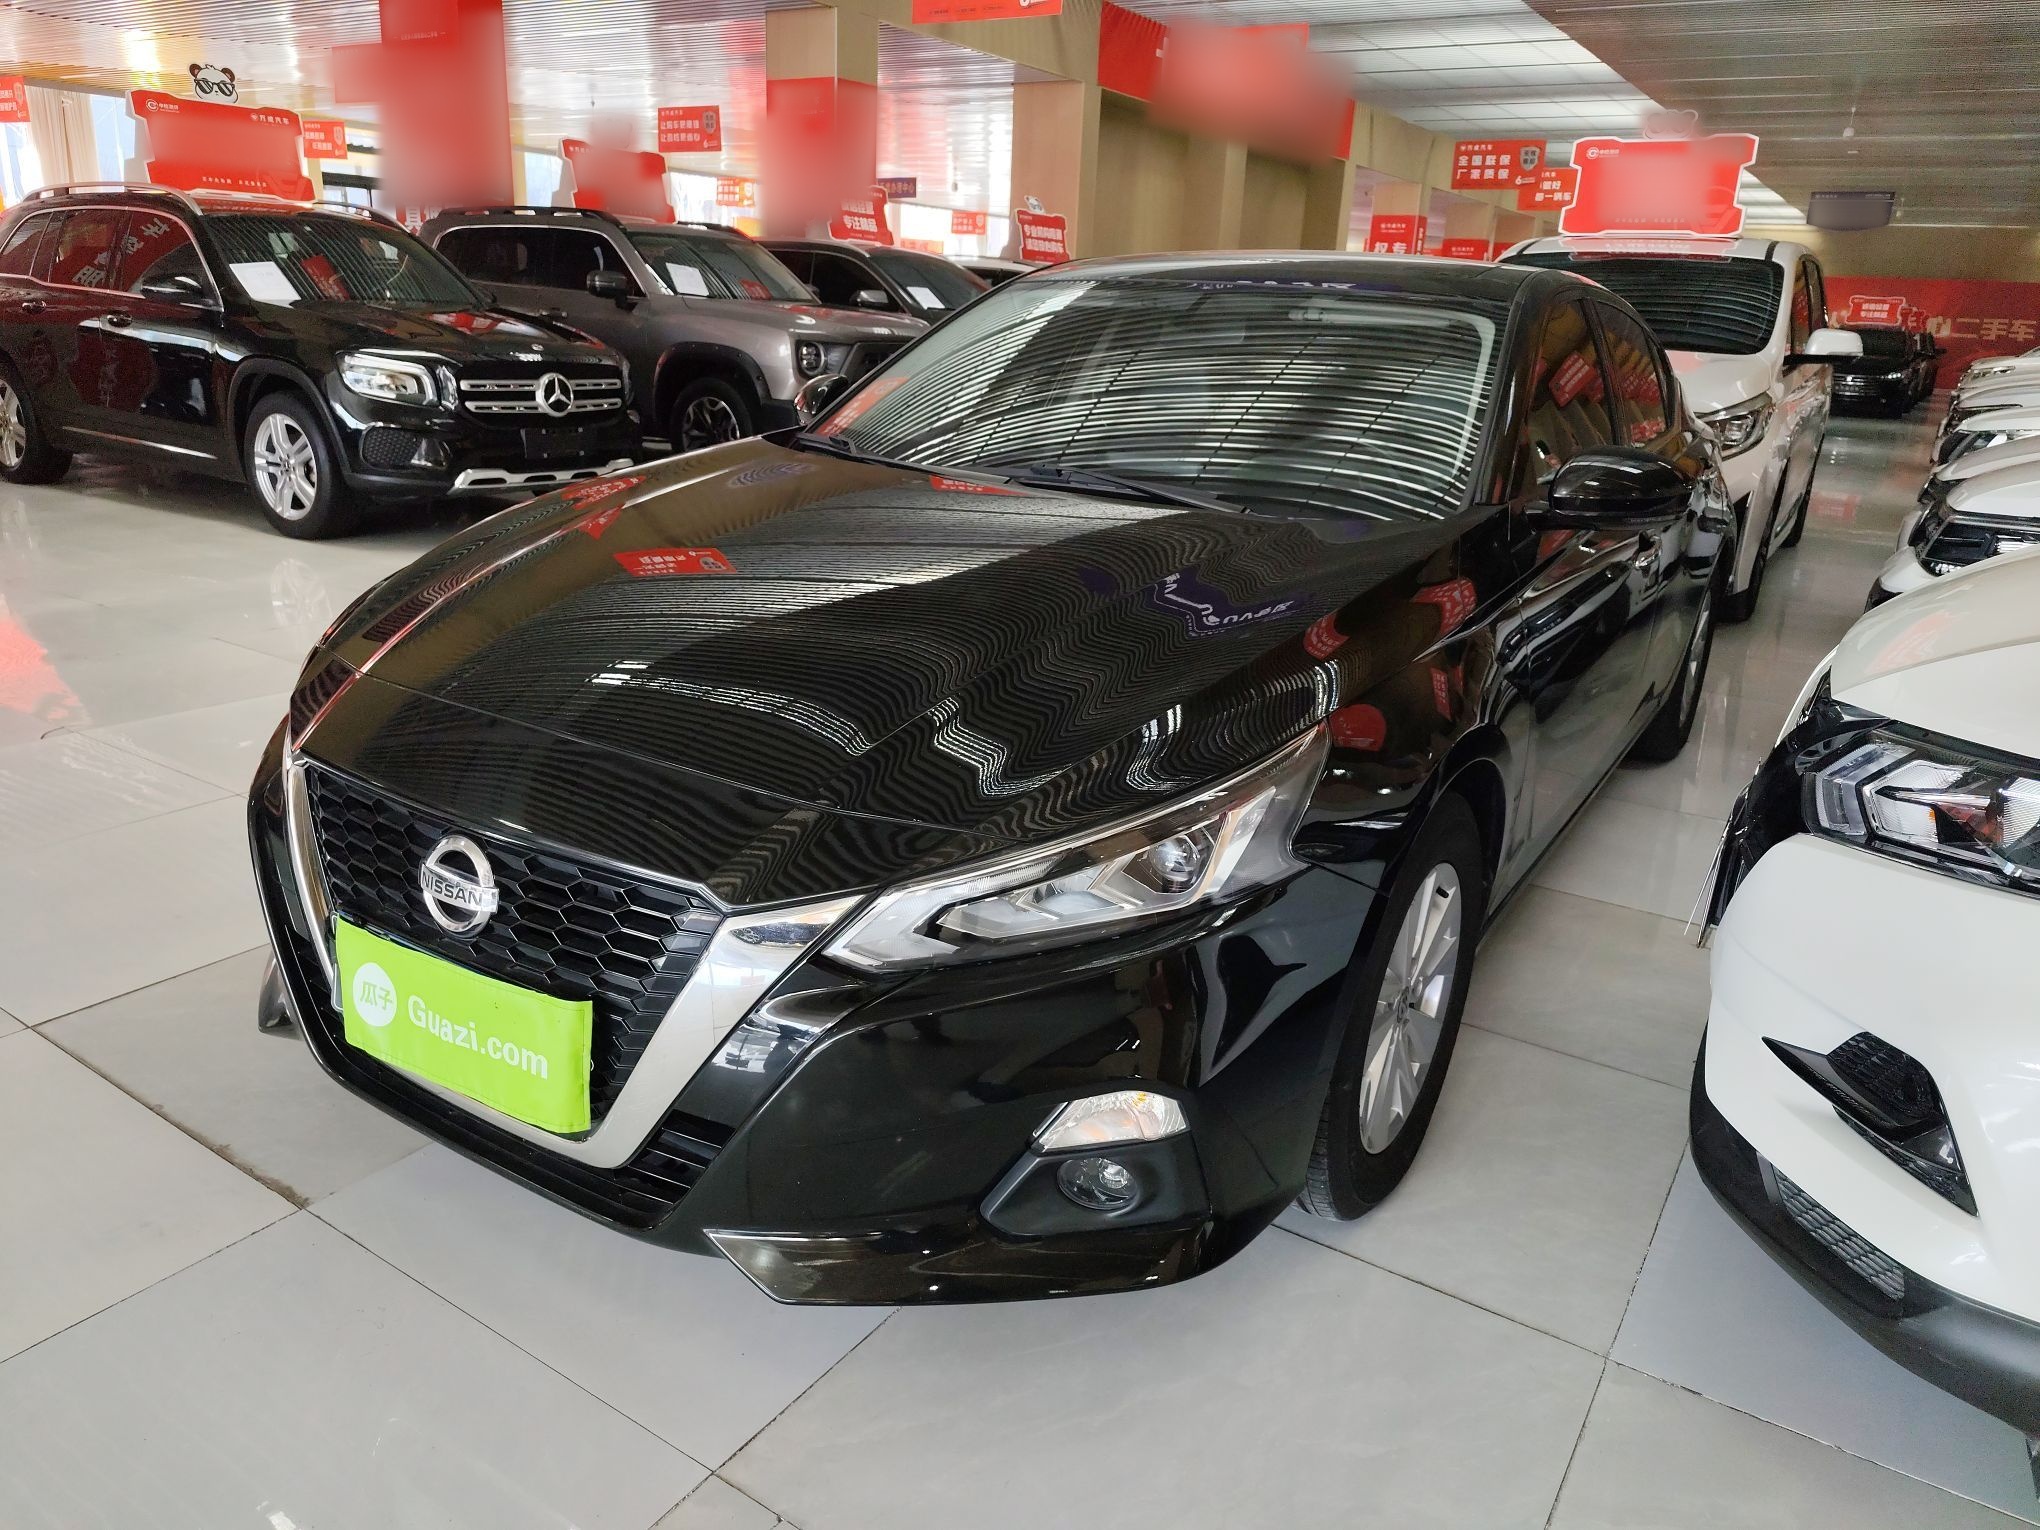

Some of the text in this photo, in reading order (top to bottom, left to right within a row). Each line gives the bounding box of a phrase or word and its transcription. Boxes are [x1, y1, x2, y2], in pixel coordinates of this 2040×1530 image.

[422, 872, 482, 906] NISSAN
[359, 980, 549, 1081] 瓜子 Guazi.com
